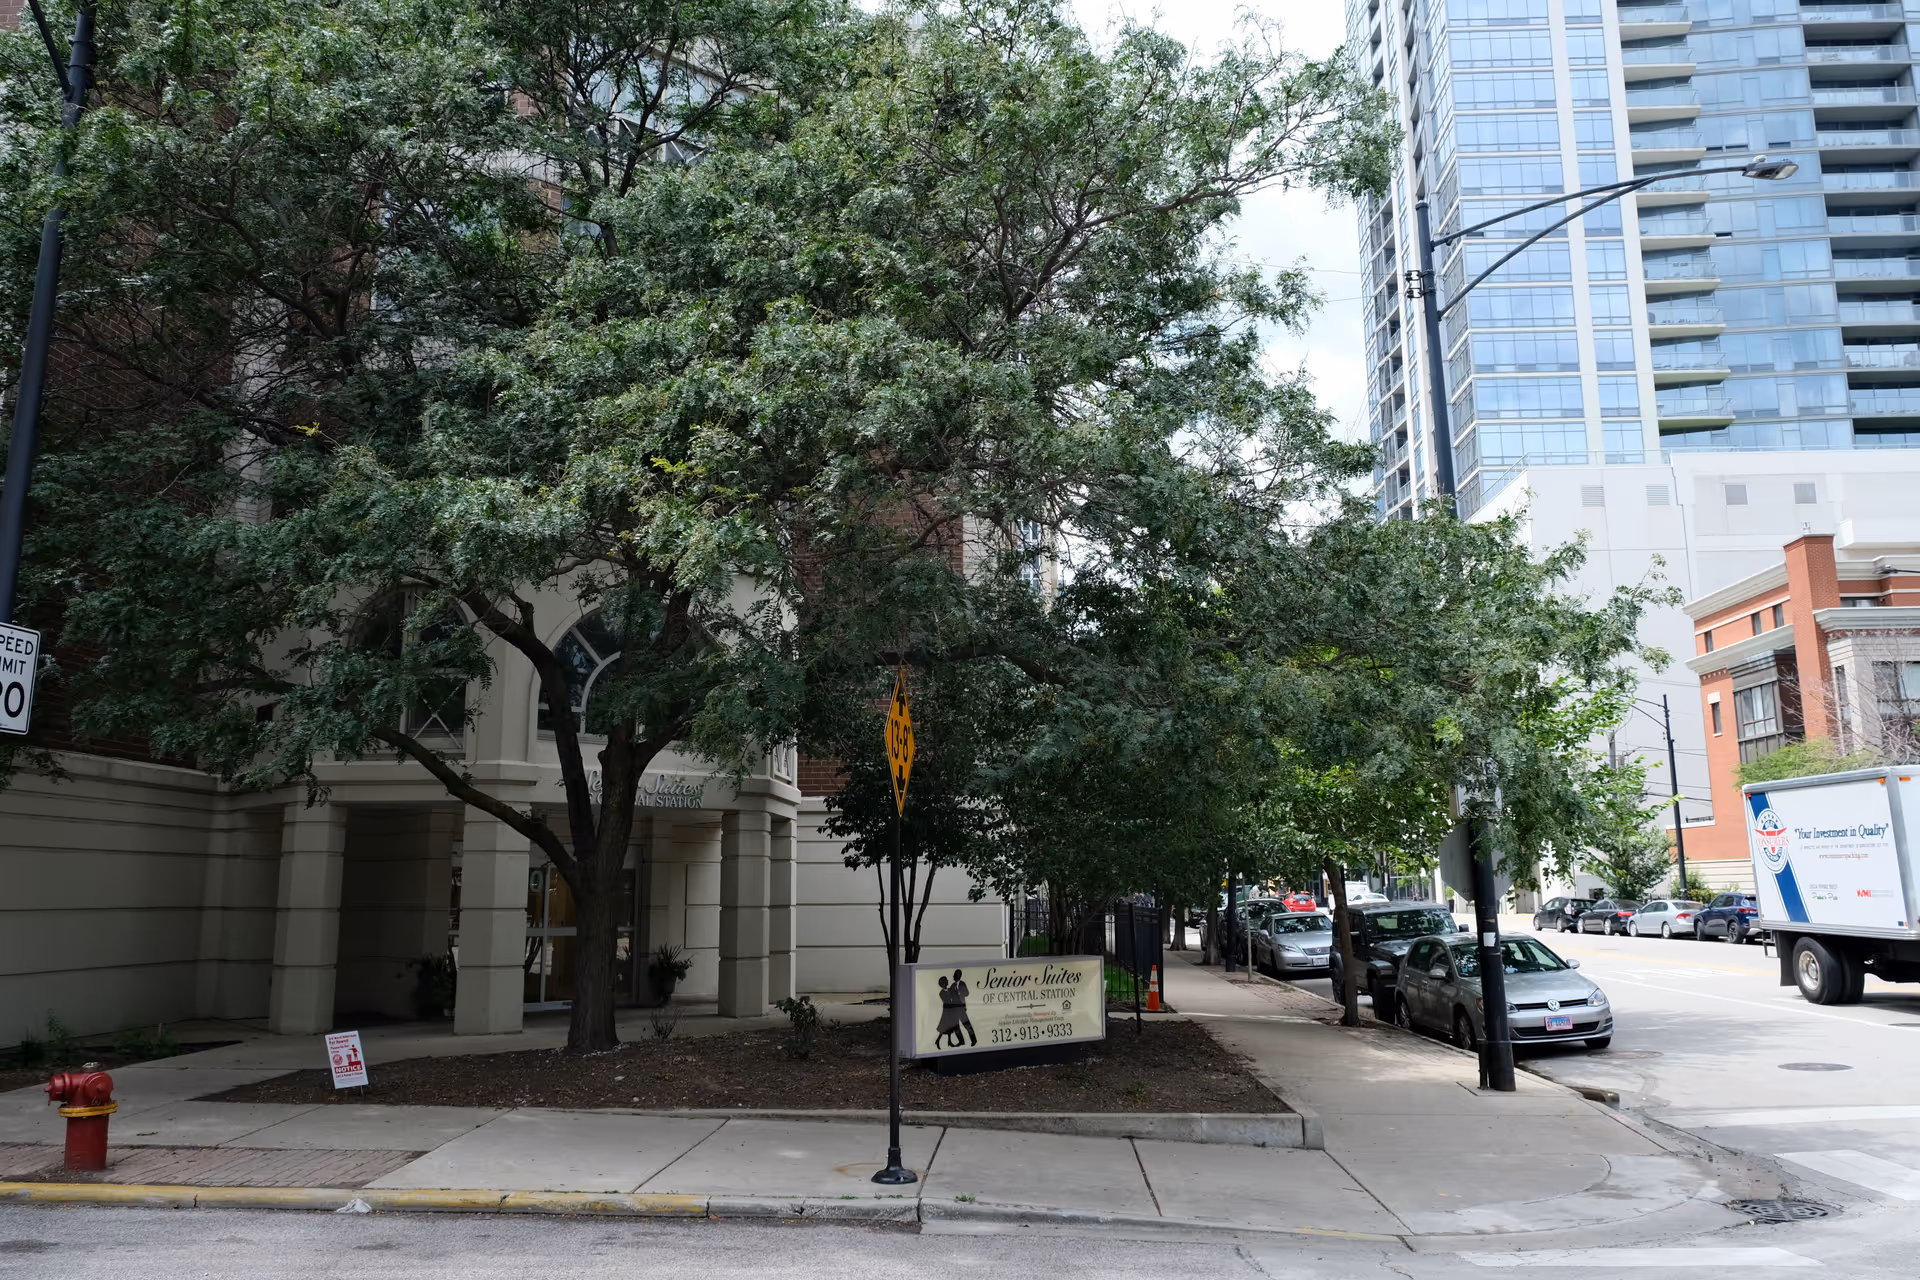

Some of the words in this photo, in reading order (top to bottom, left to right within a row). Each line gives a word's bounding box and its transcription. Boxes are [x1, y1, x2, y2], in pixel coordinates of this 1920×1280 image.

[0, 680, 25, 718] 0
[656, 794, 704, 809] STATION
[1813, 827, 1848, 839] Investment
[1850, 826, 1856, 837] in
[976, 967, 1032, 990] Senior
[1034, 963, 1082, 986] Suites
[983, 992, 995, 1005] OF
[997, 990, 1039, 1003] CENTRAL
[1040, 987, 1076, 1000] STATION
[335, 1065, 362, 1073] NOTICE
